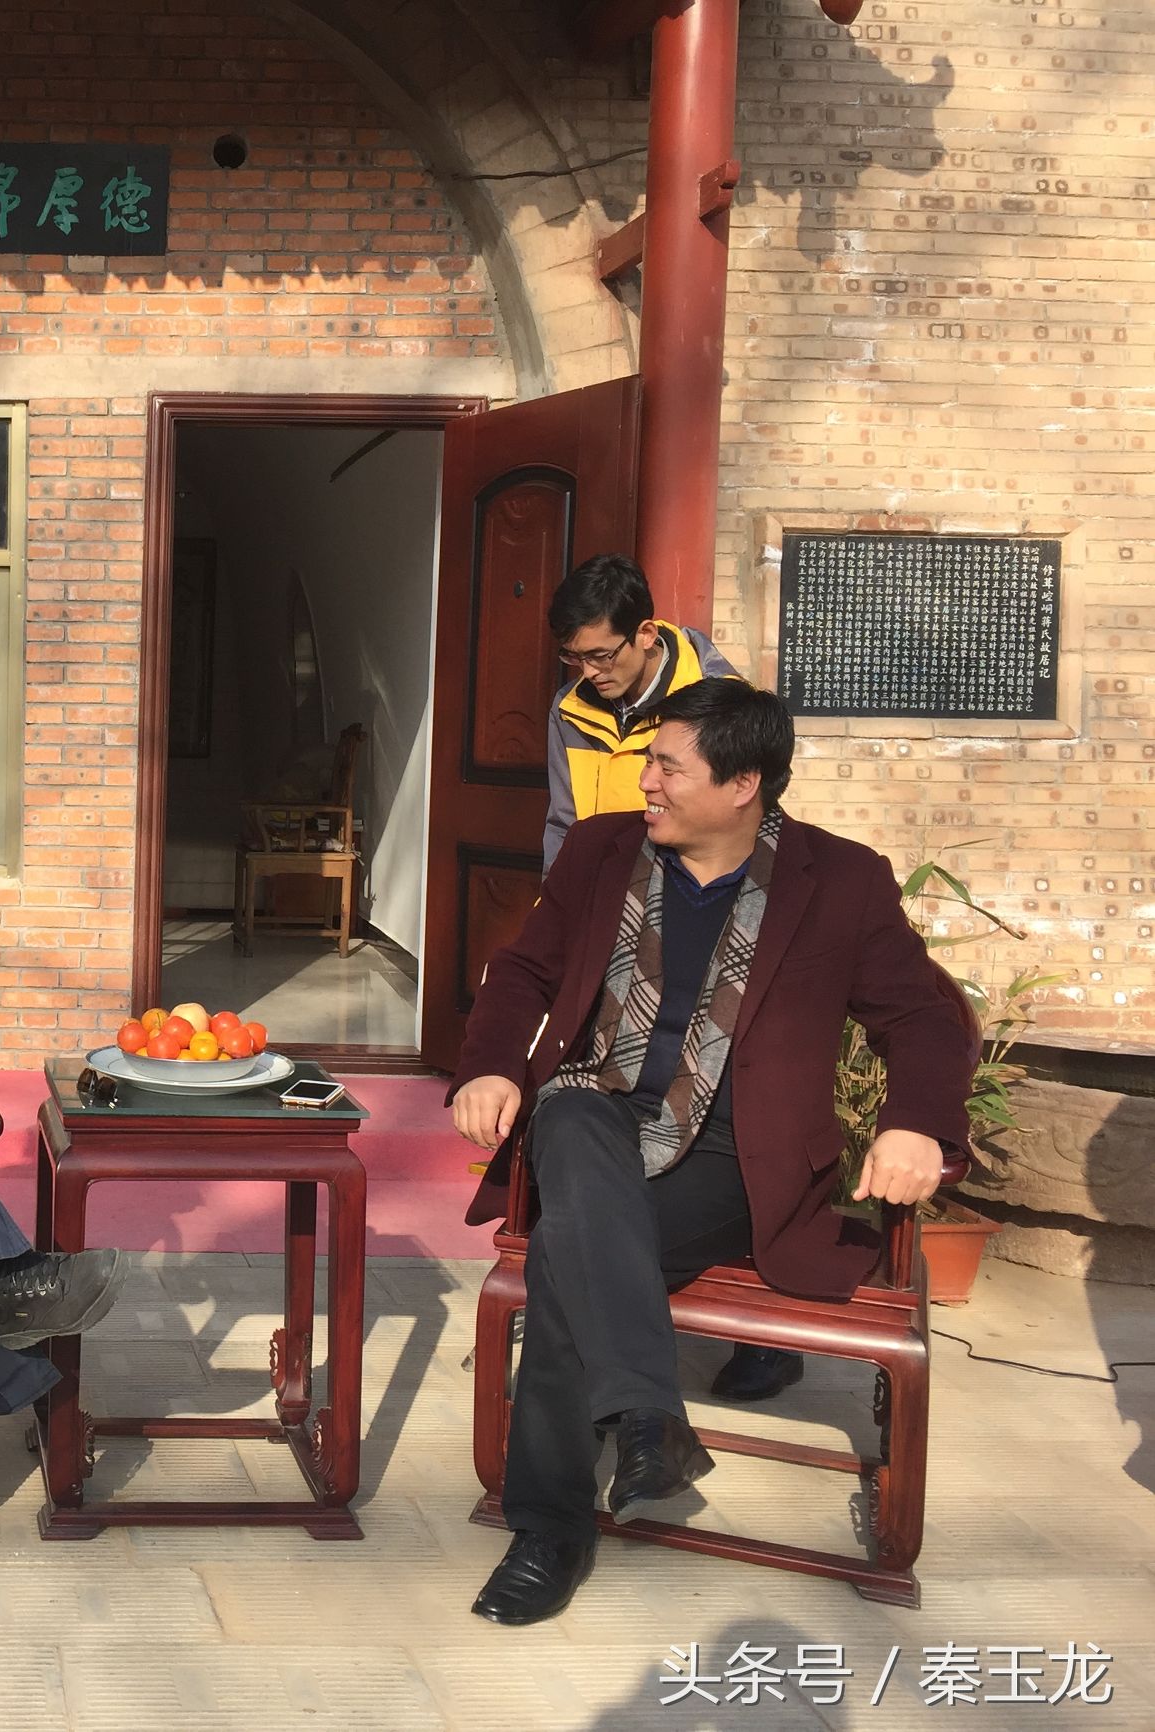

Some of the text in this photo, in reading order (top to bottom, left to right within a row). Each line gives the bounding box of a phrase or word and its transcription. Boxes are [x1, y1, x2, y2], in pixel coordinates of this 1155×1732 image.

[1039, 564, 1054, 678] 修葺崆峒蒋氏故居记
